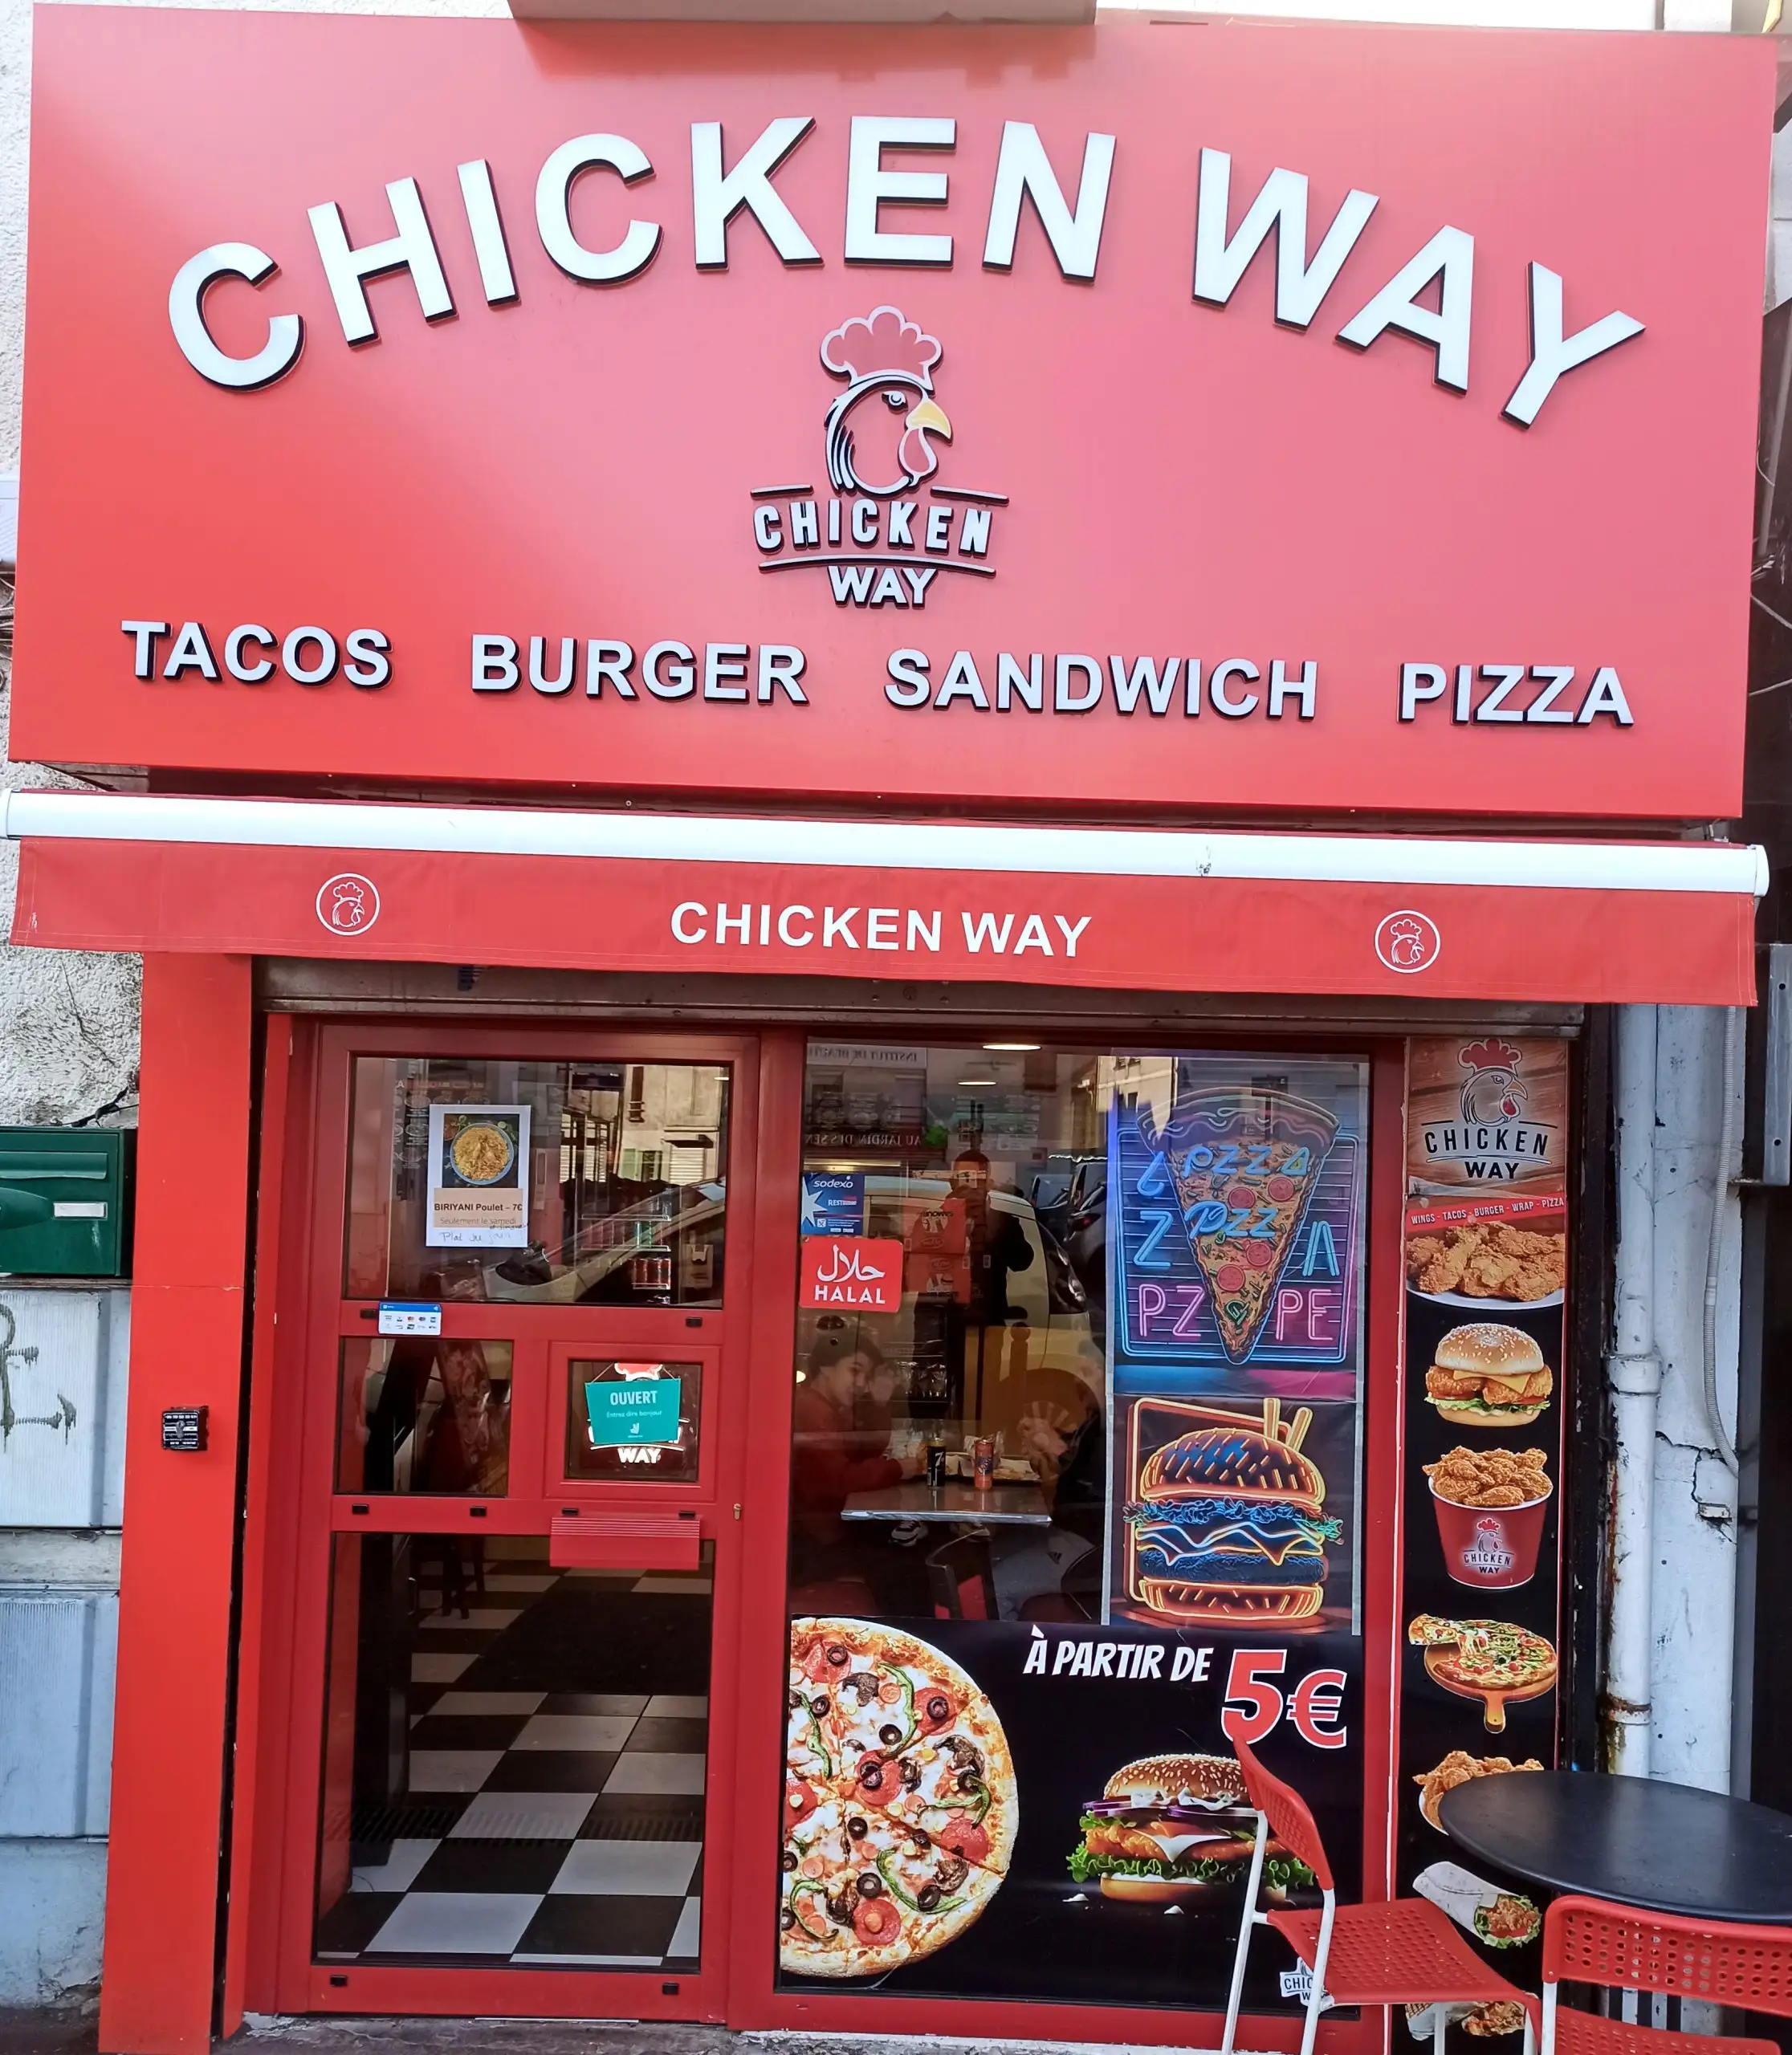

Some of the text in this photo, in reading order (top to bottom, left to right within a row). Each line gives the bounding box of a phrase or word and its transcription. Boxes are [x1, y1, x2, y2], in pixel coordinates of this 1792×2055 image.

[168, 116, 1646, 429] CHICKEN WAY
[753, 498, 992, 557] CHICKEN
[828, 565, 938, 608] WAY
[121, 619, 1634, 726] TACOS BURGER SANDWICH PIZZA
[670, 901, 1092, 957] CHICKEN WAY
[1424, 1127, 1549, 1156] CHICKEN
[1464, 1161, 1520, 1179] WAY
[813, 1176, 853, 1189] sodexo
[434, 1203, 473, 1211] BIRIYANI
[476, 1203, 503, 1211] Poulet
[1411, 1213, 1436, 1225] WINGS
[1443, 1209, 1467, 1220] TACOS
[1474, 1205, 1505, 1217] BURGER
[1512, 1199, 1534, 1211] WRAP
[1542, 1197, 1564, 1208] PIZZA
[440, 1217, 516, 1225] Seulement le samedi
[817, 1244, 886, 1283] حلال
[814, 1284, 886, 1304] HALAL
[610, 1390, 658, 1406] OUVERT
[617, 1447, 662, 1463] WAY
[1464, 1553, 1510, 1565] CHICKEN
[1479, 1566, 1500, 1574] WAY
[1023, 1624, 1214, 1683] À PARTIR DE
[1220, 1648, 1348, 1749] 5€
[1284, 1976, 1314, 1990] CHIC
